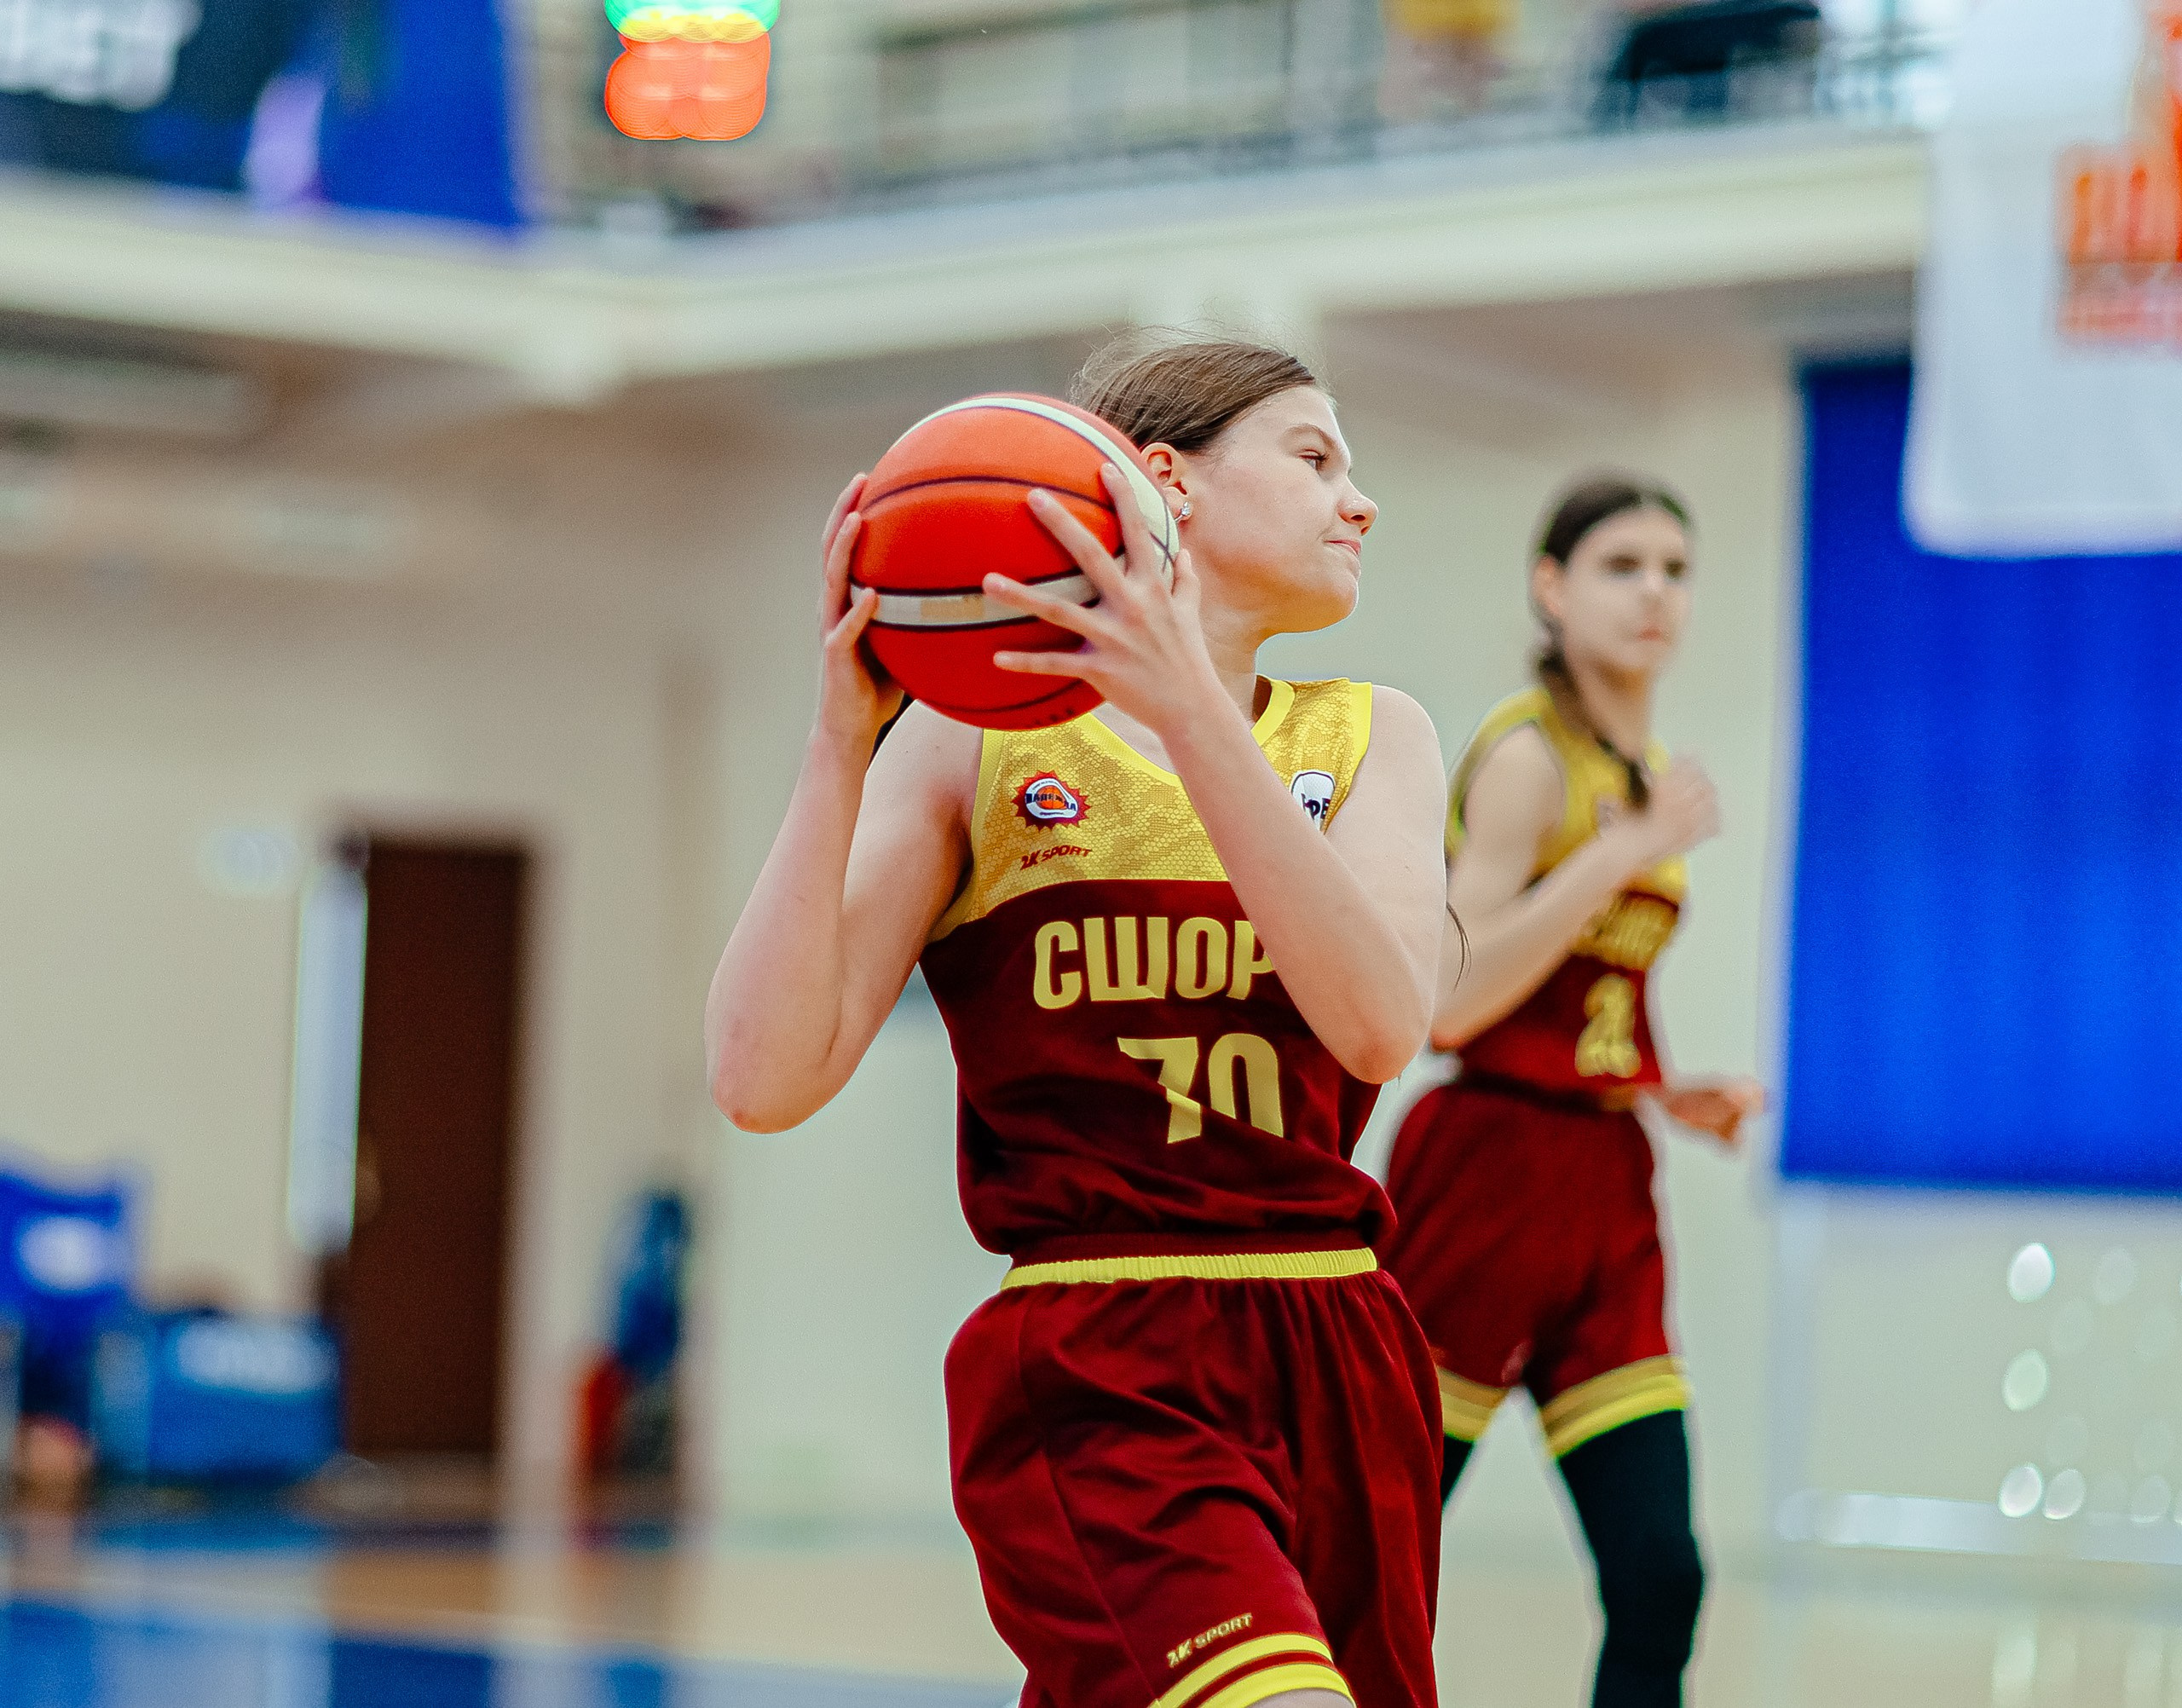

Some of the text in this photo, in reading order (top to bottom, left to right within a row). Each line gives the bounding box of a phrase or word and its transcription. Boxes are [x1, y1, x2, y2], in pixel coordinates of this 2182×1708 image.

[1041, 845, 1093, 862] SPORT
[1033, 916, 1276, 1010] СШОР
[1117, 1033, 1284, 1144] 70
[1193, 1613, 1253, 1648] SPORT
